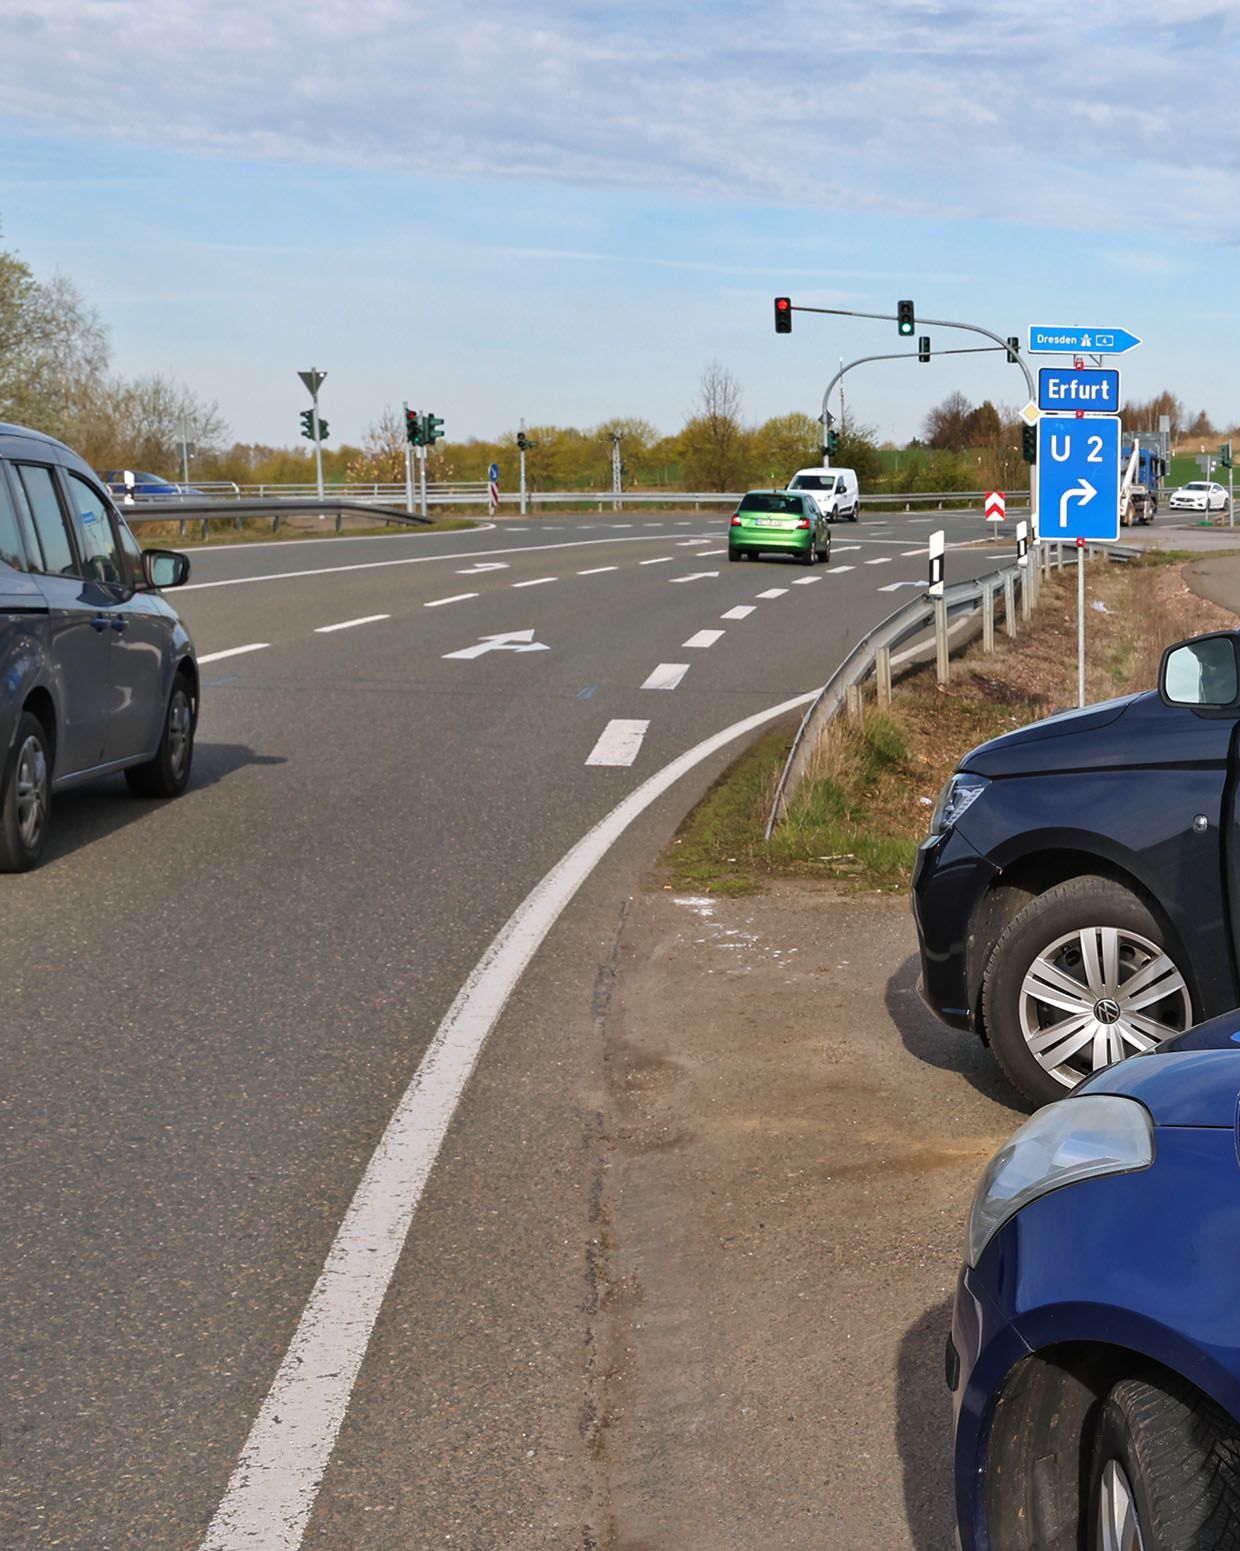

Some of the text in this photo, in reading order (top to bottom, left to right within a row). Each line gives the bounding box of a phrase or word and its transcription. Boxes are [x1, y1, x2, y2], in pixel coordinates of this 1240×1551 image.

[1037, 334, 1077, 345] Dresden
[1048, 379, 1110, 400] Erfurt
[1051, 435, 1103, 463] U 2
